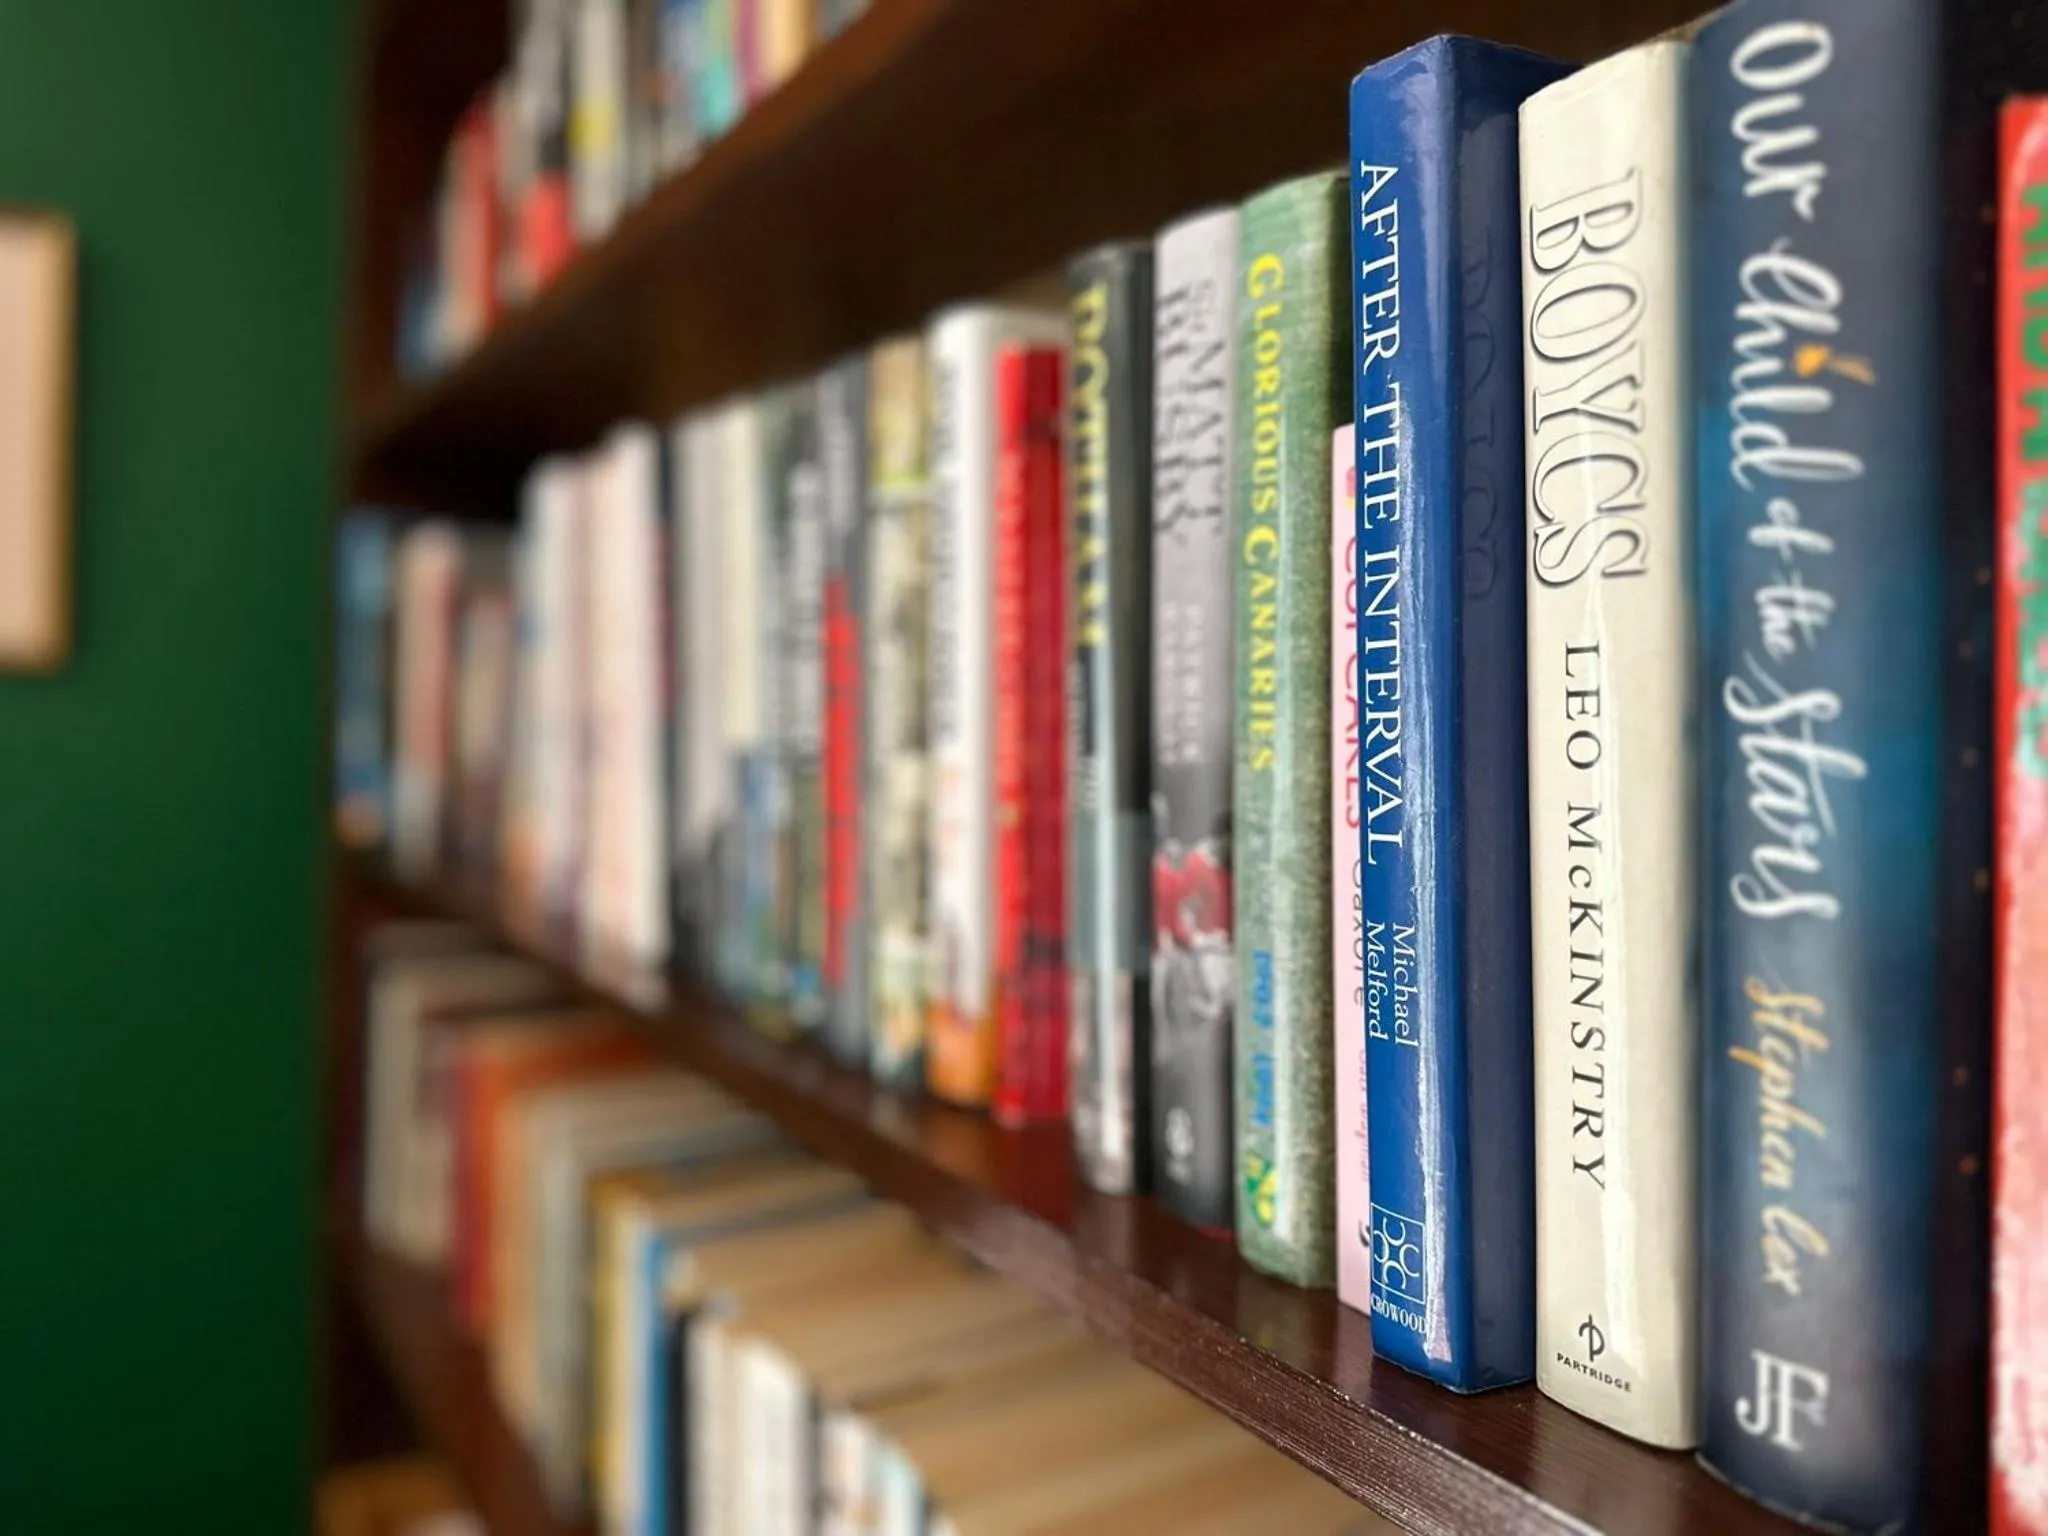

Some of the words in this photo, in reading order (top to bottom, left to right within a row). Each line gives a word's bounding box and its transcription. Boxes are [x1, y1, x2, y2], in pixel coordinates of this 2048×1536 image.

[1730, 20, 1833, 222] Our
[1359, 160, 1399, 375] AFTER
[1729, 236, 1865, 493] Child
[1248, 253, 1284, 514] GLORIOUS
[1362, 374, 1403, 531] THE
[1530, 167, 1648, 590] BOYCS
[1747, 497, 1835, 564] of
[1755, 574, 1836, 664] the
[1244, 524, 1279, 772] CANARIES
[1364, 543, 1404, 866] INTERVAL
[1564, 641, 1603, 770] LEO
[1723, 650, 1868, 920] Stars
[1366, 918, 1390, 1041] Melford
[1392, 921, 1420, 1047] Michael
[1566, 800, 1607, 1190] McKINSTRY
[1727, 975, 1830, 1190] Stephen
[1370, 1293, 1428, 1335] CROWOOD
[1556, 1351, 1633, 1393] PARTRIDGE
